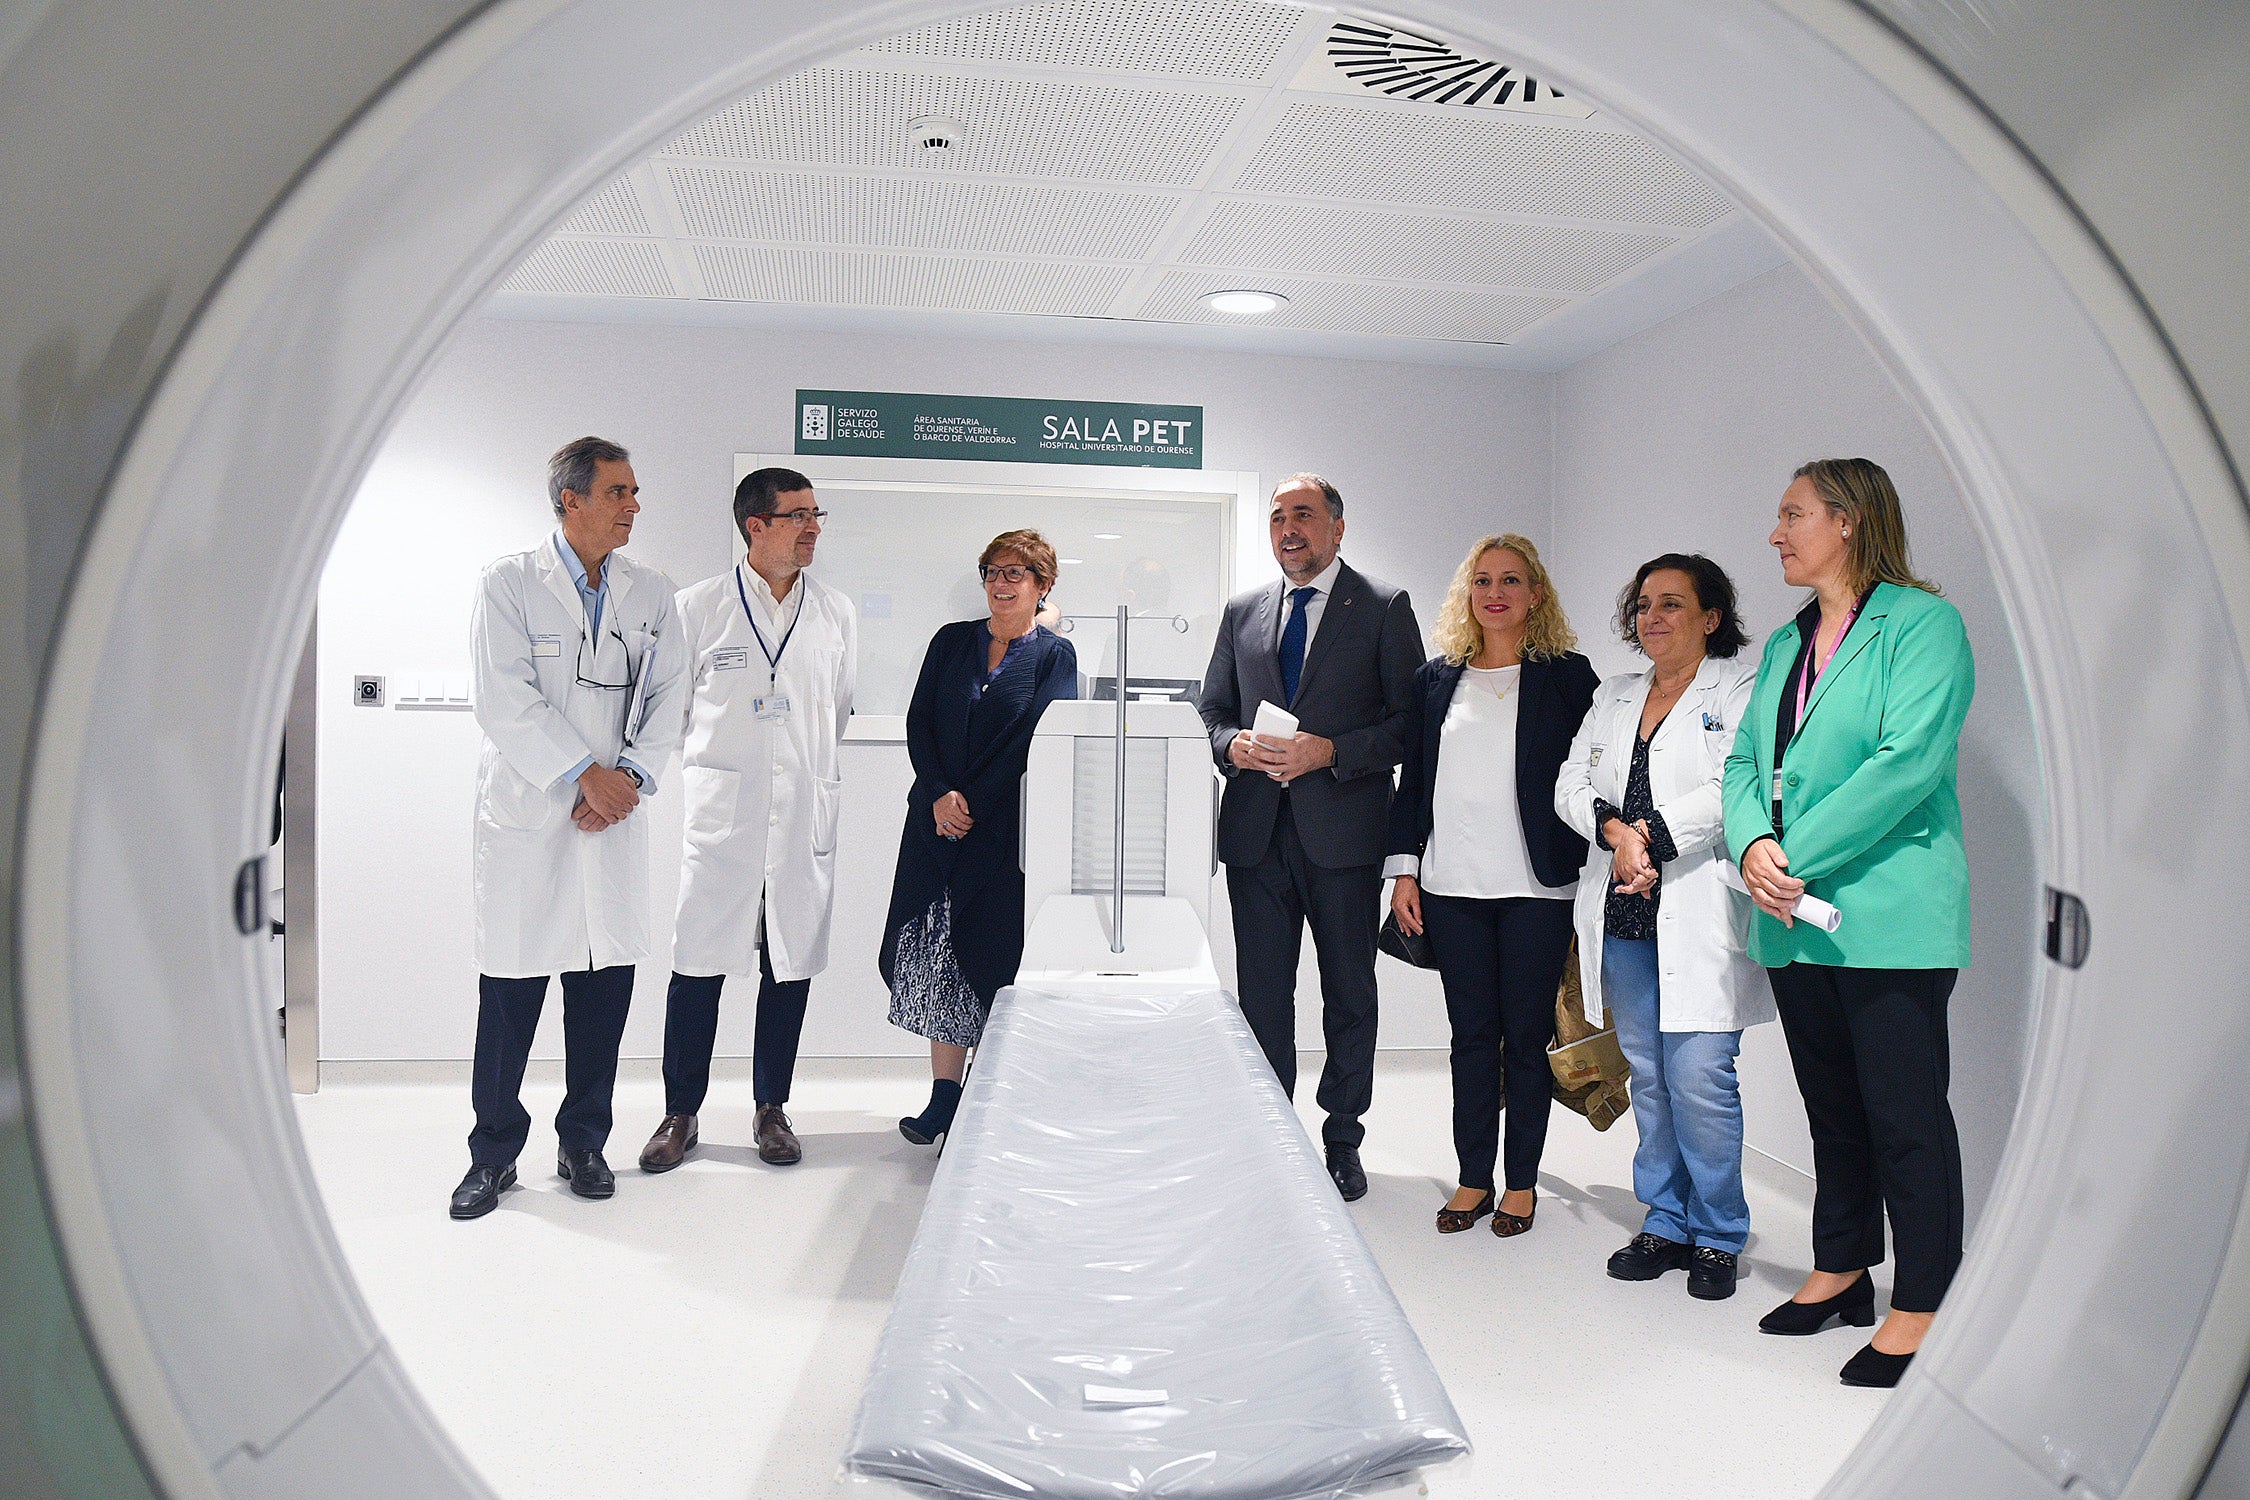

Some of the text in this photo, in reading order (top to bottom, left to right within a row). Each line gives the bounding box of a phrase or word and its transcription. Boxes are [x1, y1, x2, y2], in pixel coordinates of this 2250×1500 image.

[837, 408, 878, 418] SERVIZO
[838, 418, 879, 429] GALEGO
[914, 414, 980, 426] ÁREA SANITARIA
[837, 427, 886, 439] DE SAÚDE
[914, 425, 998, 435] DE OURENSE, VERÍN E
[1042, 415, 1192, 445] SALA PET
[914, 433, 1017, 445] O BARCO DE VALDEORRAS
[1039, 441, 1194, 455] HOSPITAL UNIVERSITARIO DE OURENSE
